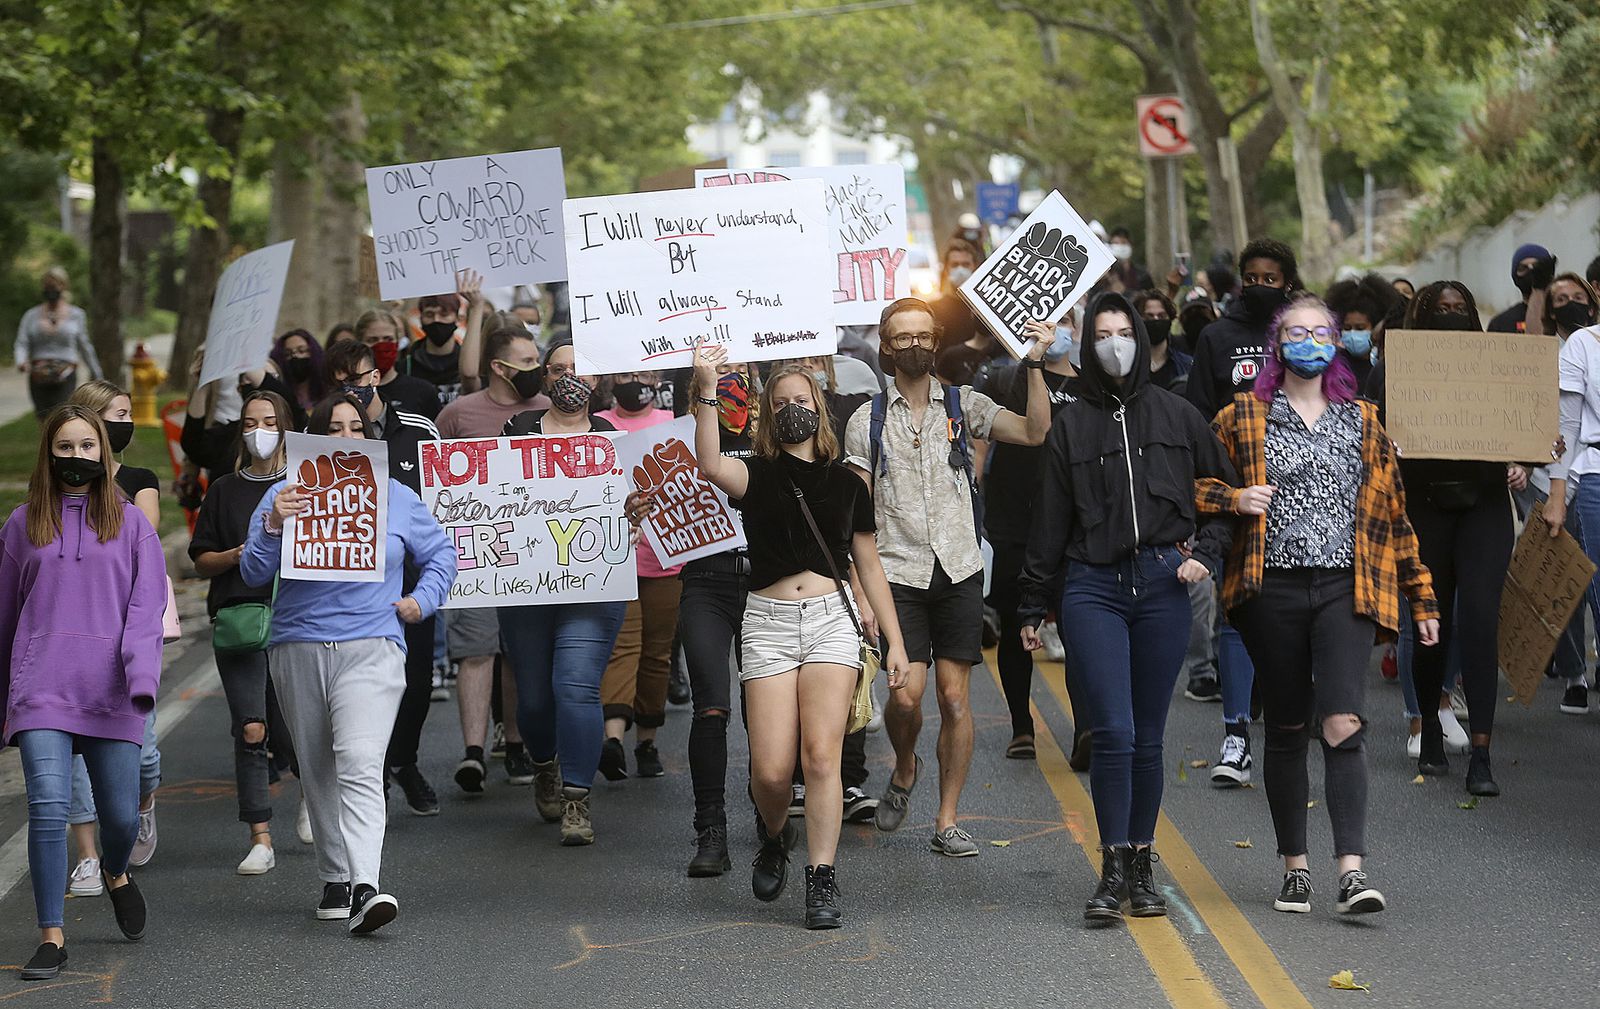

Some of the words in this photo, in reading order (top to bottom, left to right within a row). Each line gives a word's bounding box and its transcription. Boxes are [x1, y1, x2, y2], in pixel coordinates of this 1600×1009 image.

[383, 162, 437, 194] ONLY
[486, 157, 508, 177] A
[418, 181, 524, 225] COWARD
[376, 226, 439, 255] SHOOTS
[461, 208, 554, 242] SOMEONE
[579, 212, 604, 251] I
[654, 216, 708, 236] never
[384, 258, 407, 281] IN
[420, 247, 471, 274] THE
[486, 238, 547, 269] BACK
[668, 241, 697, 274] But
[1006, 246, 1073, 301] BLACK
[575, 294, 600, 324] I
[658, 289, 719, 322] always
[992, 260, 1055, 321] LIVES
[1235, 345, 1263, 354] UTAH
[1423, 355, 1449, 382] day
[1241, 363, 1254, 376] U
[421, 439, 499, 488] NOT
[296, 513, 375, 543] LIVES
[652, 490, 721, 537] LIVES
[519, 536, 543, 558] for
[545, 517, 631, 566] YOU
[661, 514, 734, 555] MATTER
[295, 541, 375, 568] MATTER
[494, 572, 533, 597] Lives
